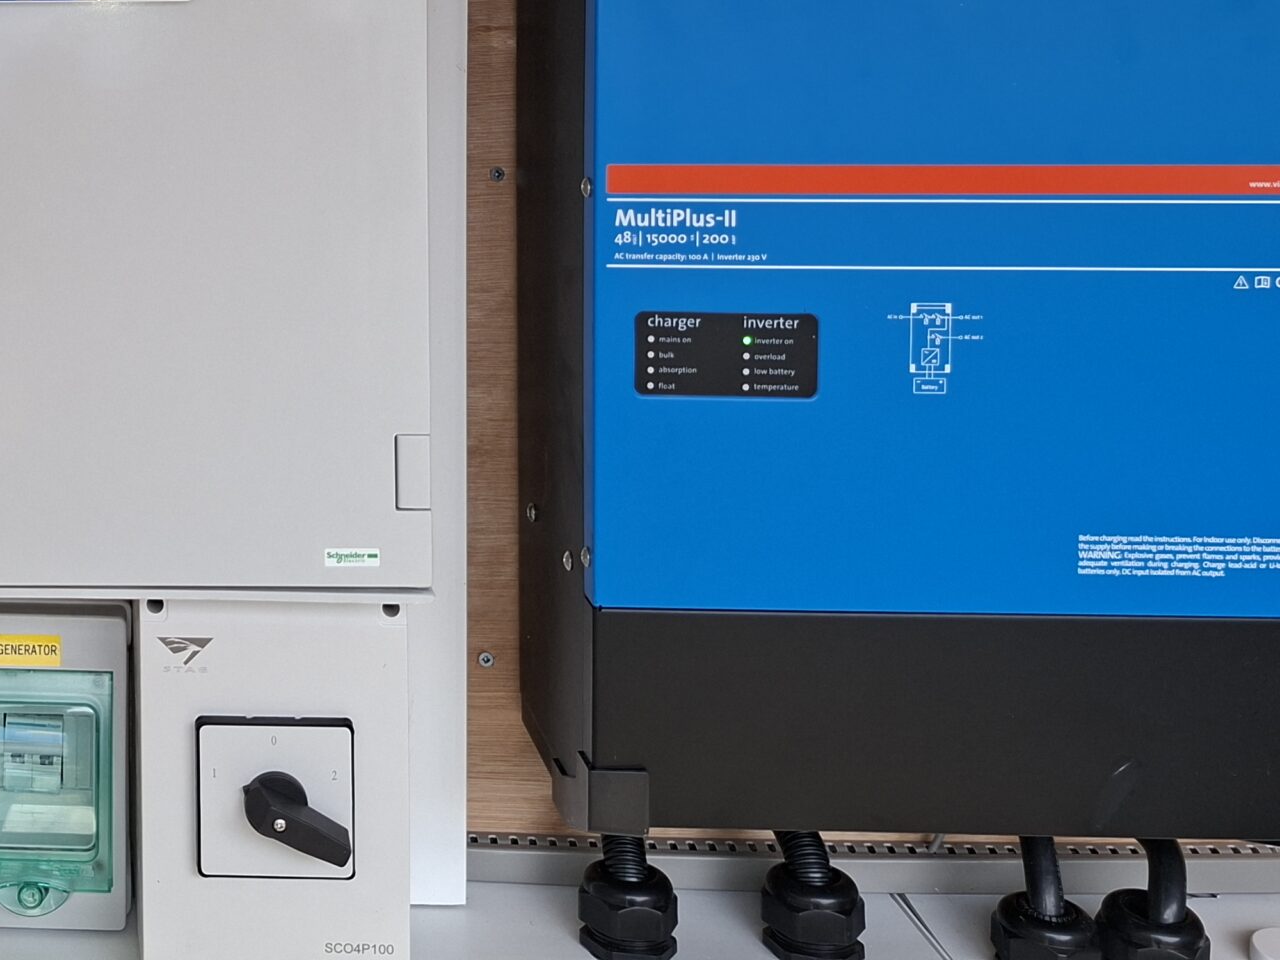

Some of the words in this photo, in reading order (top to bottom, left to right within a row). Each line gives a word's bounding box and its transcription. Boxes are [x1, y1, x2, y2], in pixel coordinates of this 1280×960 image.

[615, 207, 737, 228] MultiPlus-II
[614, 231, 632, 246] 48
[646, 234, 687, 246] 15000
[702, 234, 729, 244] 200
[614, 252, 624, 260] AC
[626, 252, 654, 261] transfer
[655, 253, 687, 262] capacity:
[702, 253, 709, 261] A
[717, 253, 745, 261] Inverter
[747, 254, 759, 263] 230
[761, 253, 767, 261] V
[647, 315, 701, 331] charger
[743, 316, 799, 329] inverter
[754, 337, 782, 345] inverter
[658, 351, 675, 359] bulk
[754, 353, 786, 361] overload
[658, 366, 697, 375] absorption
[769, 368, 796, 377] battery
[658, 382, 675, 390] float
[754, 383, 799, 392] temperature
[1100, 535, 1127, 543] charging
[1132, 544, 1157, 552] making
[1165, 544, 1192, 552] breaking
[326, 552, 366, 563] Schneider
[1124, 552, 1153, 560] Explosive
[1176, 552, 1200, 561] prevent
[1078, 560, 1108, 568] adequate
[1147, 561, 1168, 569] during
[1203, 561, 1225, 569] Charge
[1132, 569, 1149, 577] input
[271, 736, 277, 746] 0
[212, 768, 217, 779] 1
[331, 770, 338, 781] 2
